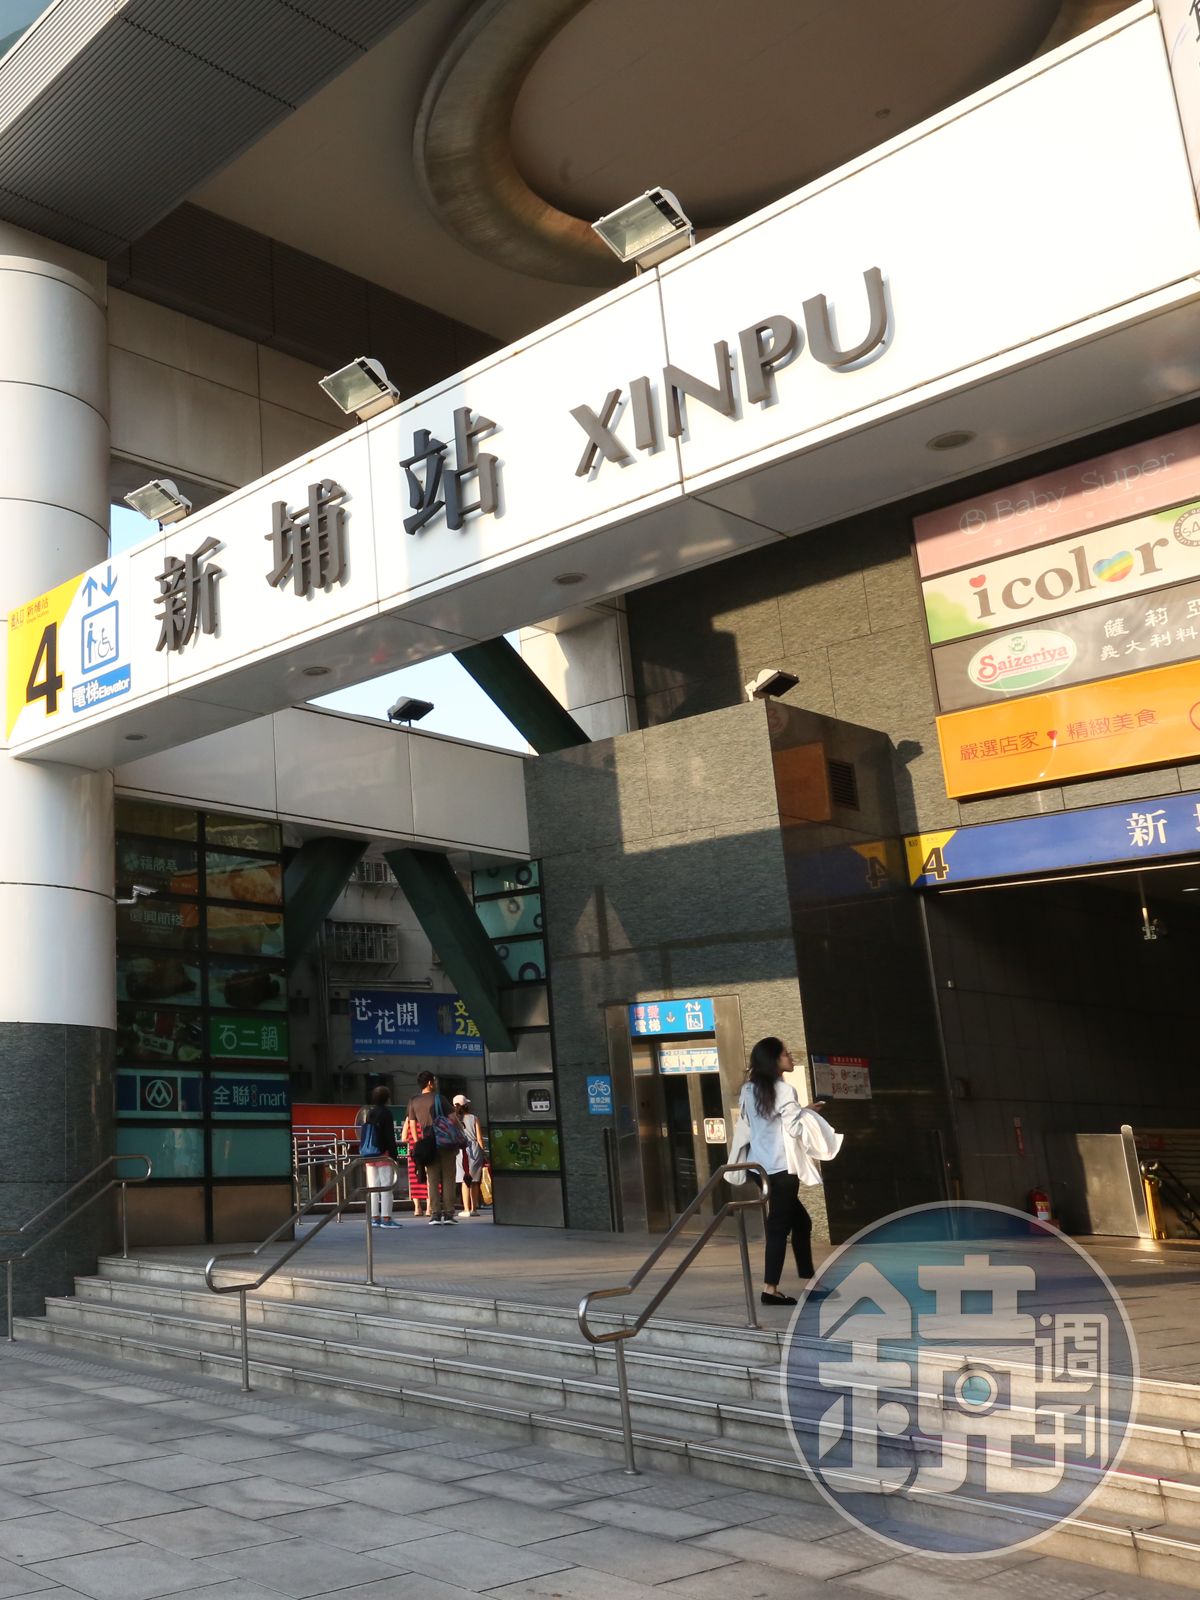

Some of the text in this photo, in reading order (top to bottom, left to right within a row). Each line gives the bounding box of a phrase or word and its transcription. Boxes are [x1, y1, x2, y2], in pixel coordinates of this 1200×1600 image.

[569, 266, 893, 478] XINPU
[994, 485, 1066, 522] Baby
[1081, 452, 1176, 497] Super
[154, 406, 500, 652] 新埔站
[26, 622, 63, 714] 4
[99, 677, 130, 699] Elevator
[977, 646, 1069, 684] Saizeriya
[960, 708, 1159, 762] 嚴選店家 精緻美食
[922, 847, 948, 879] 4
[219, 1024, 278, 1051] 石二鍋
[213, 1085, 249, 1106] 全聯
